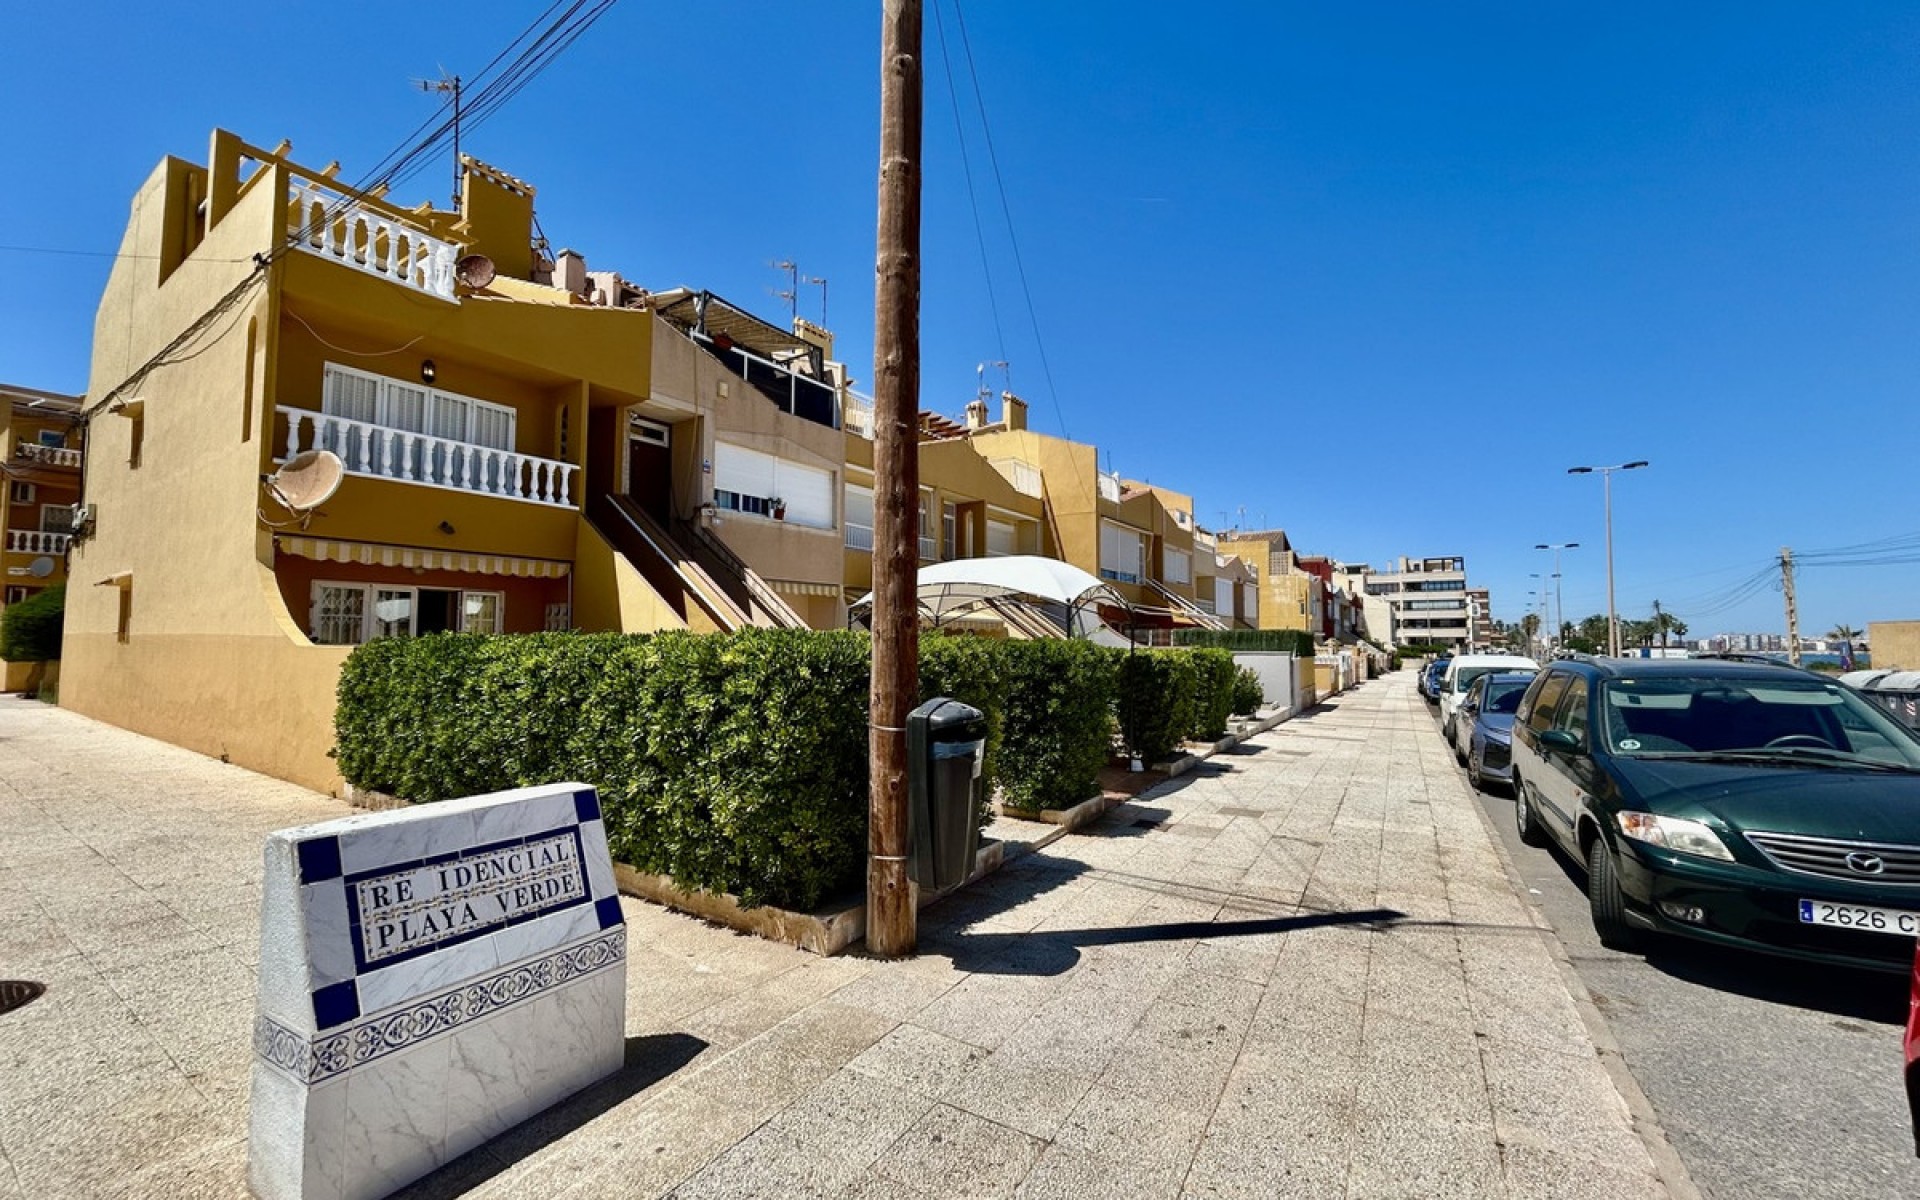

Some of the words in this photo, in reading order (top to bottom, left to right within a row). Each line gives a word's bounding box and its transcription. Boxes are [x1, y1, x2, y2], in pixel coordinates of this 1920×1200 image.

[376, 902, 478, 949] PLAYA
[496, 873, 575, 912] VERDE
[1821, 905, 1886, 929] 2626
[1898, 914, 1920, 932] C
